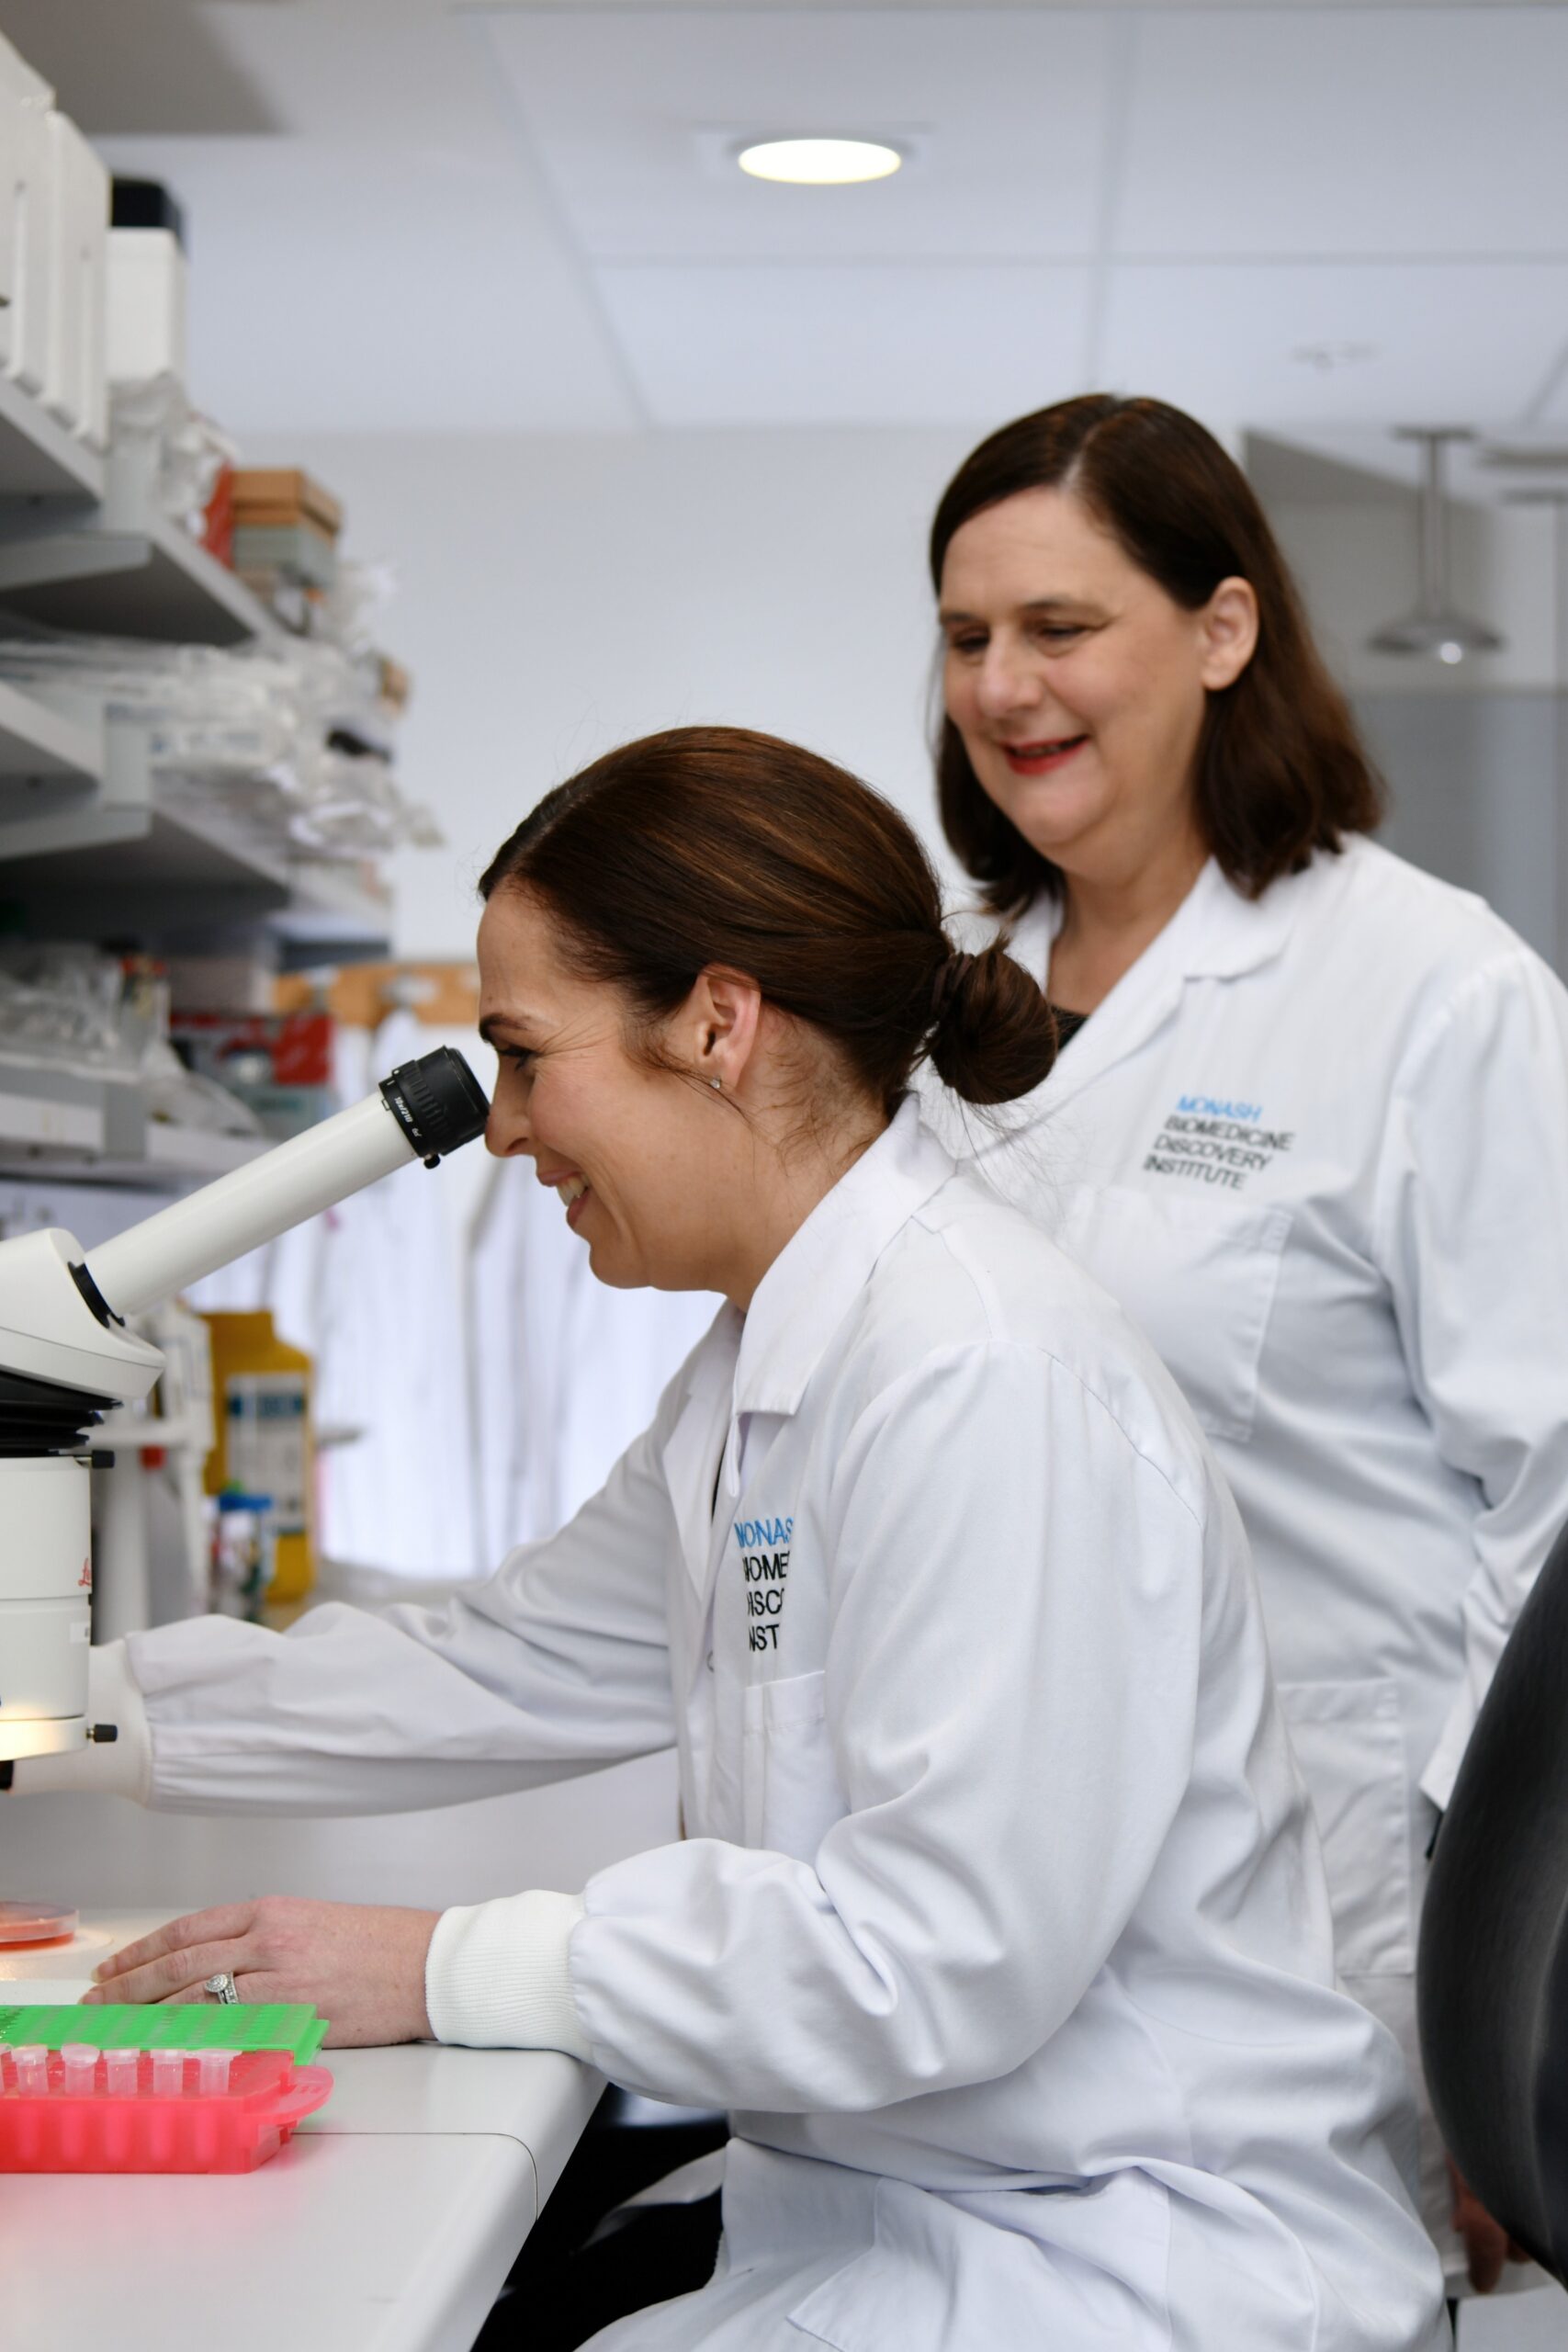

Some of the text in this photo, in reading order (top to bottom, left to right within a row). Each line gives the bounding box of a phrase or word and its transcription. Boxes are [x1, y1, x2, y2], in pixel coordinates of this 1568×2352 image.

[1177, 1096, 1263, 1123] MONASH
[1164, 1114, 1295, 1150] BIOMEDICINE
[1154, 1134, 1272, 1171] DISCOVERY
[1144, 1154, 1247, 1190] INSTITUTE
[742, 1550, 790, 1582] IOME
